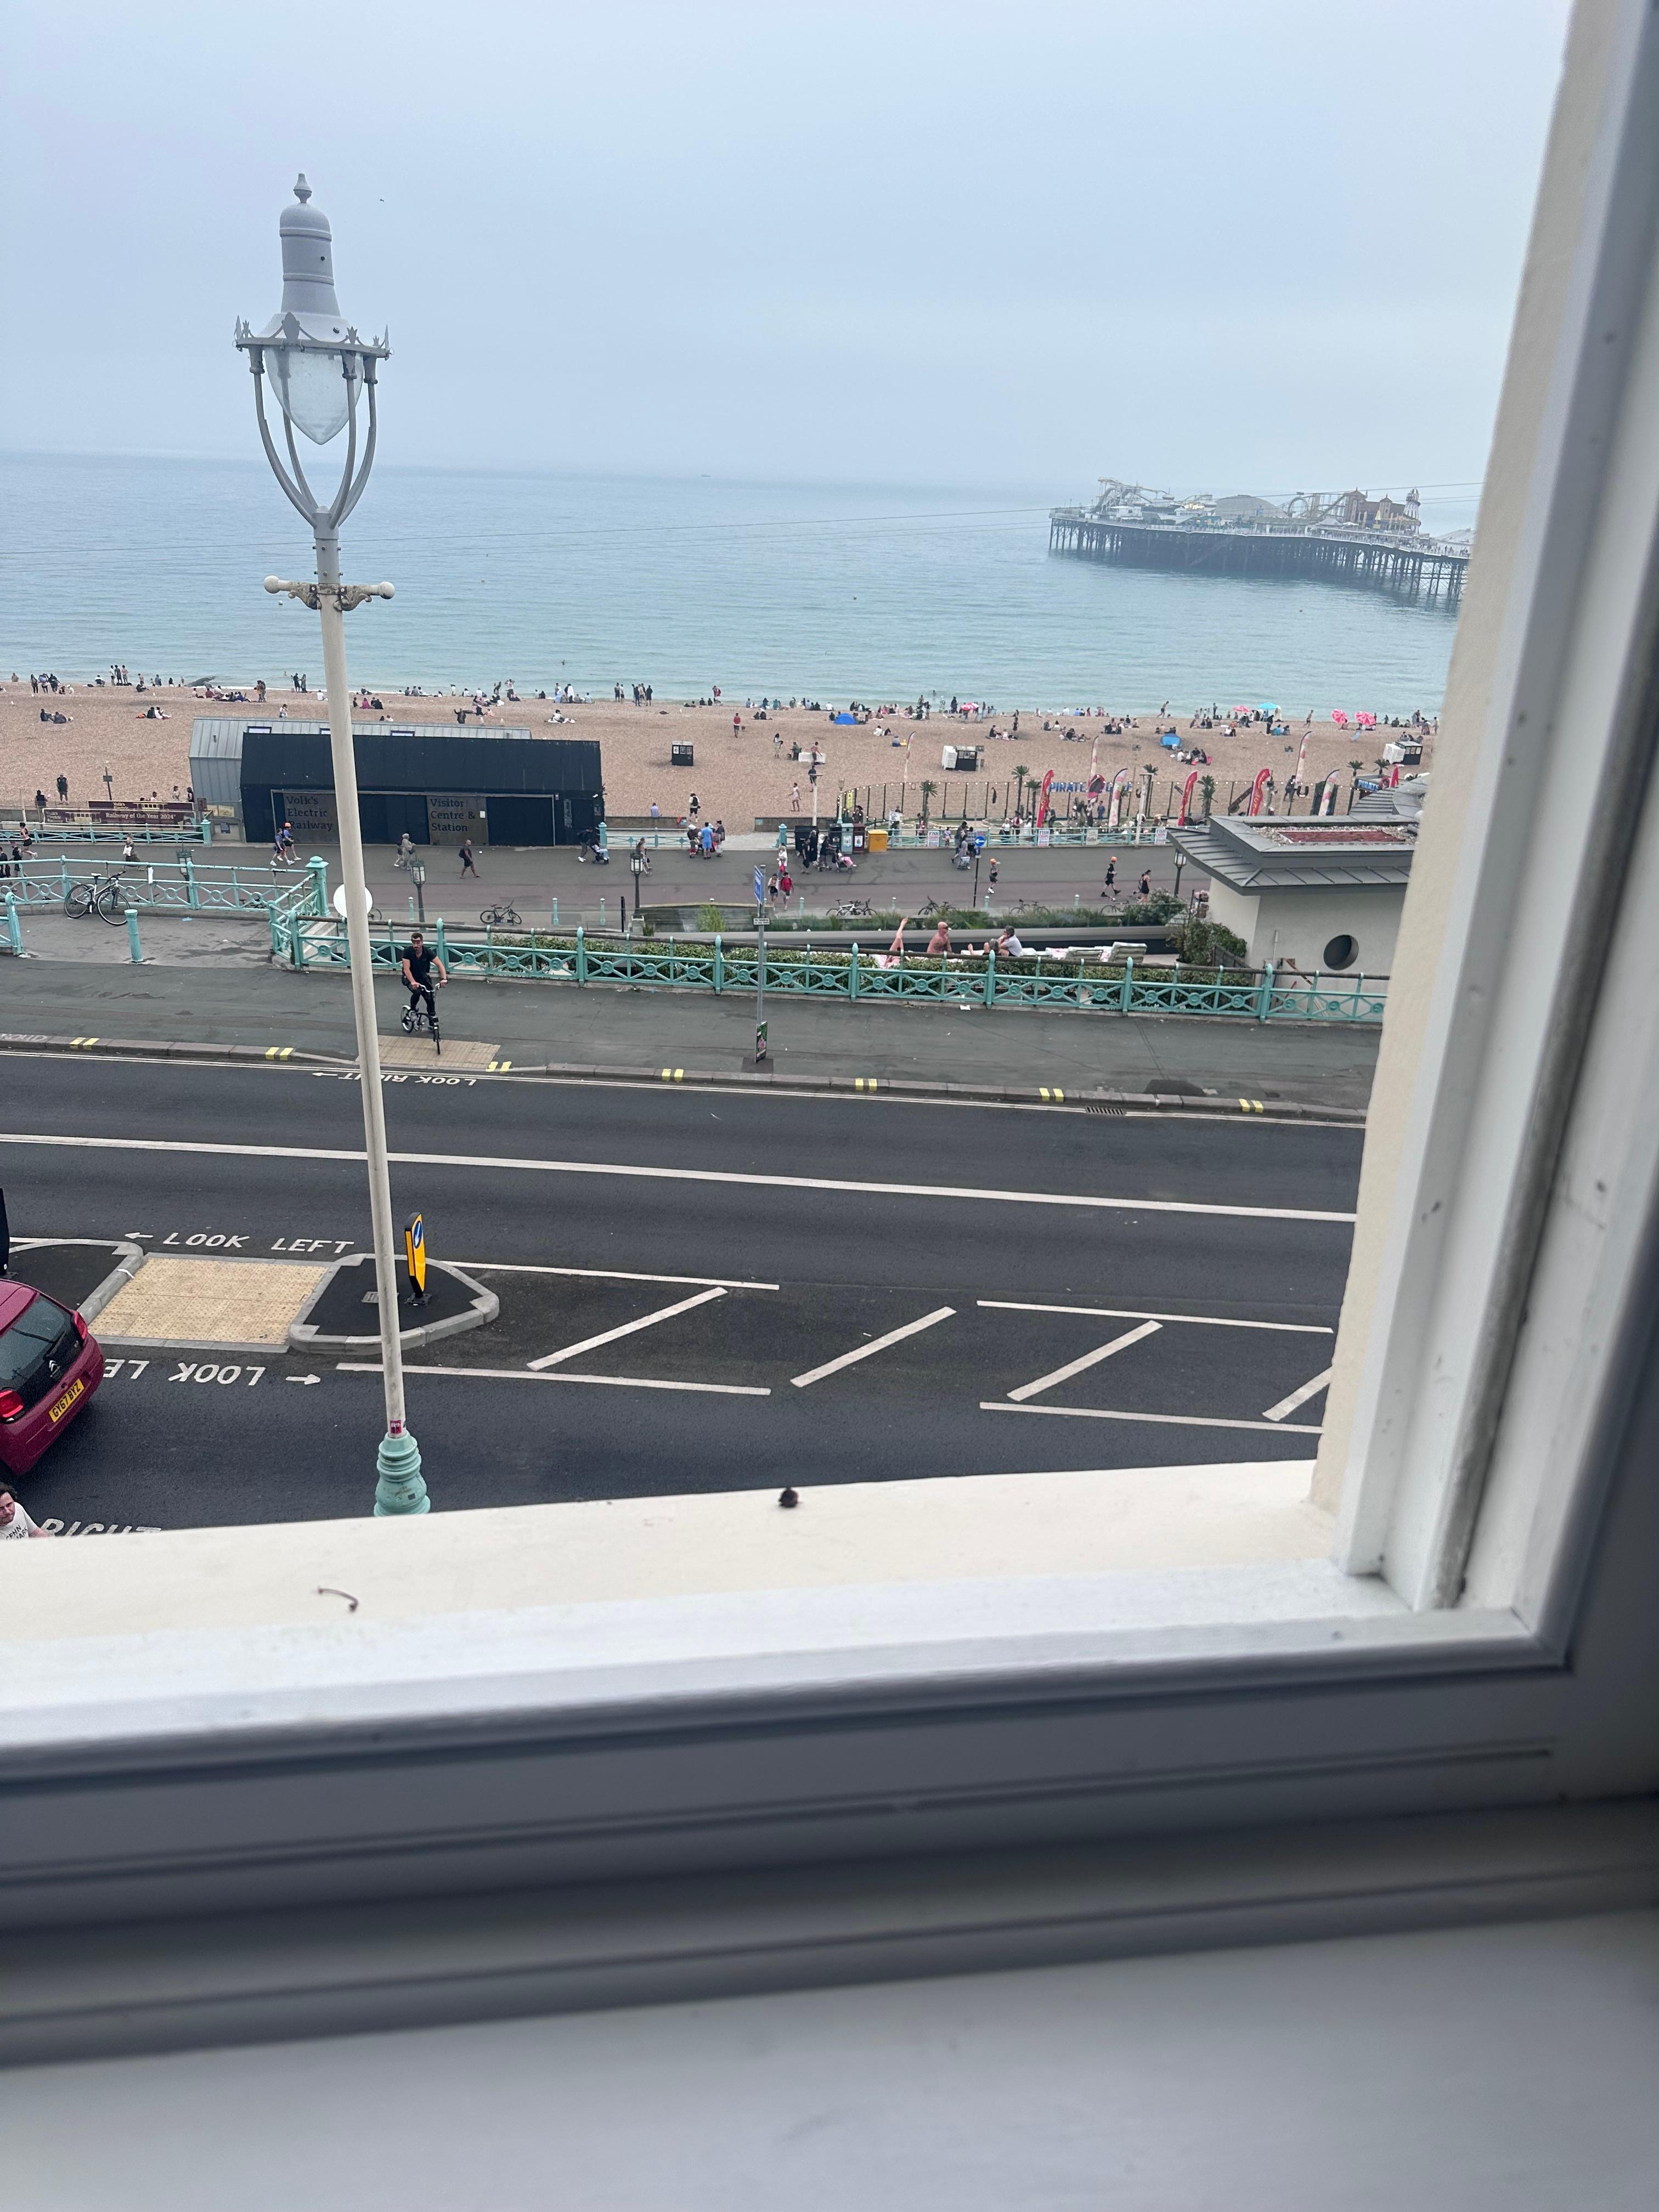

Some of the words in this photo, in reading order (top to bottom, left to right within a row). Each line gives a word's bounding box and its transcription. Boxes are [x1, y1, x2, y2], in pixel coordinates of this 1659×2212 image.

[1048, 781, 1086, 792] PIRATE
[286, 795, 318, 805] Volk's
[430, 798, 465, 807] Visitor
[287, 808, 328, 817] Electric
[431, 811, 464, 819] Centre
[468, 811, 475, 819] &
[431, 823, 468, 831] Station
[338, 1072, 409, 1082] RIT
[415, 1075, 477, 1086] LOOK
[163, 1232, 250, 1248] LOOK
[270, 1238, 355, 1254] LEFT
[103, 1358, 150, 1380] LE
[167, 1363, 267, 1386] LOOK
[52, 1396, 69, 1418] GY67
[67, 1382, 81, 1400] BYZ
